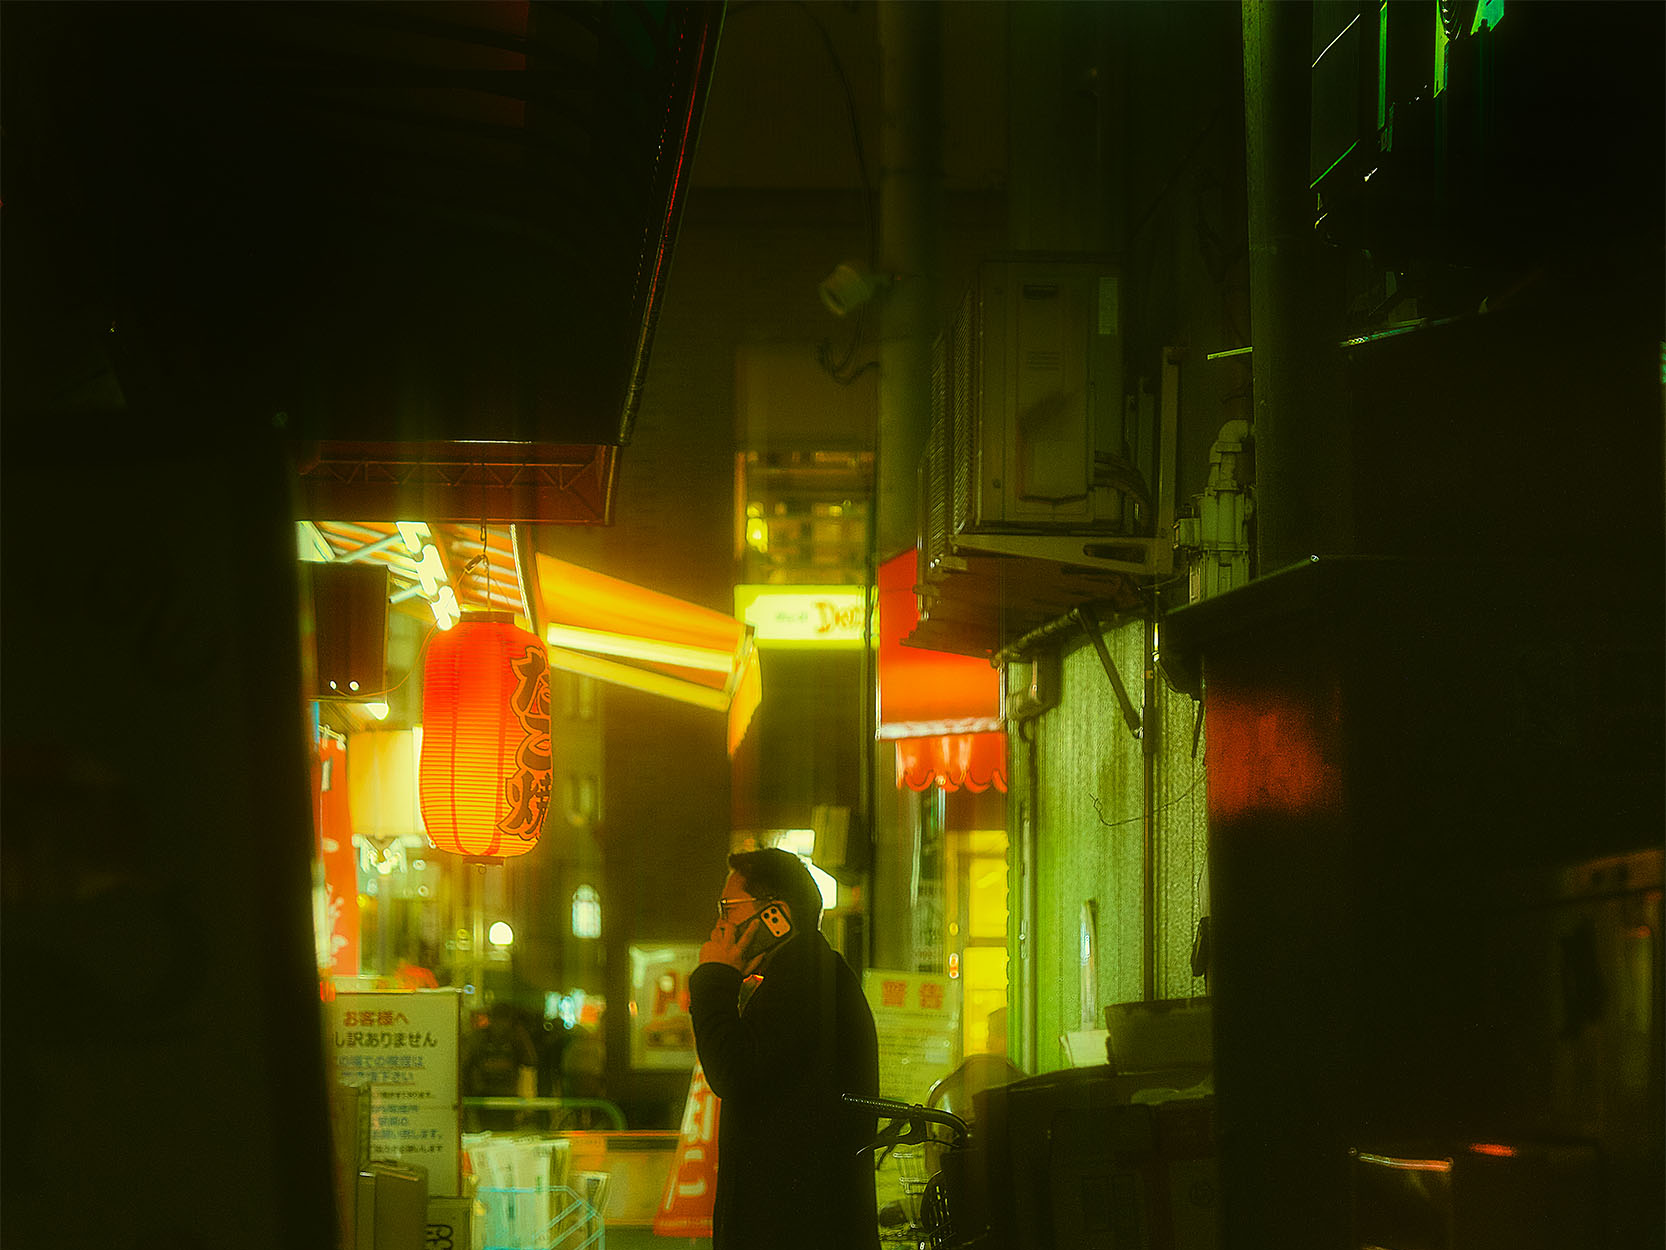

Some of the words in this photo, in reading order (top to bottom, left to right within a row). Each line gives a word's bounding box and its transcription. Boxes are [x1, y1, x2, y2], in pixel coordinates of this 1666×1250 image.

[344, 1011, 409, 1027] お客様へ
[334, 1031, 438, 1048] し訳ありません
